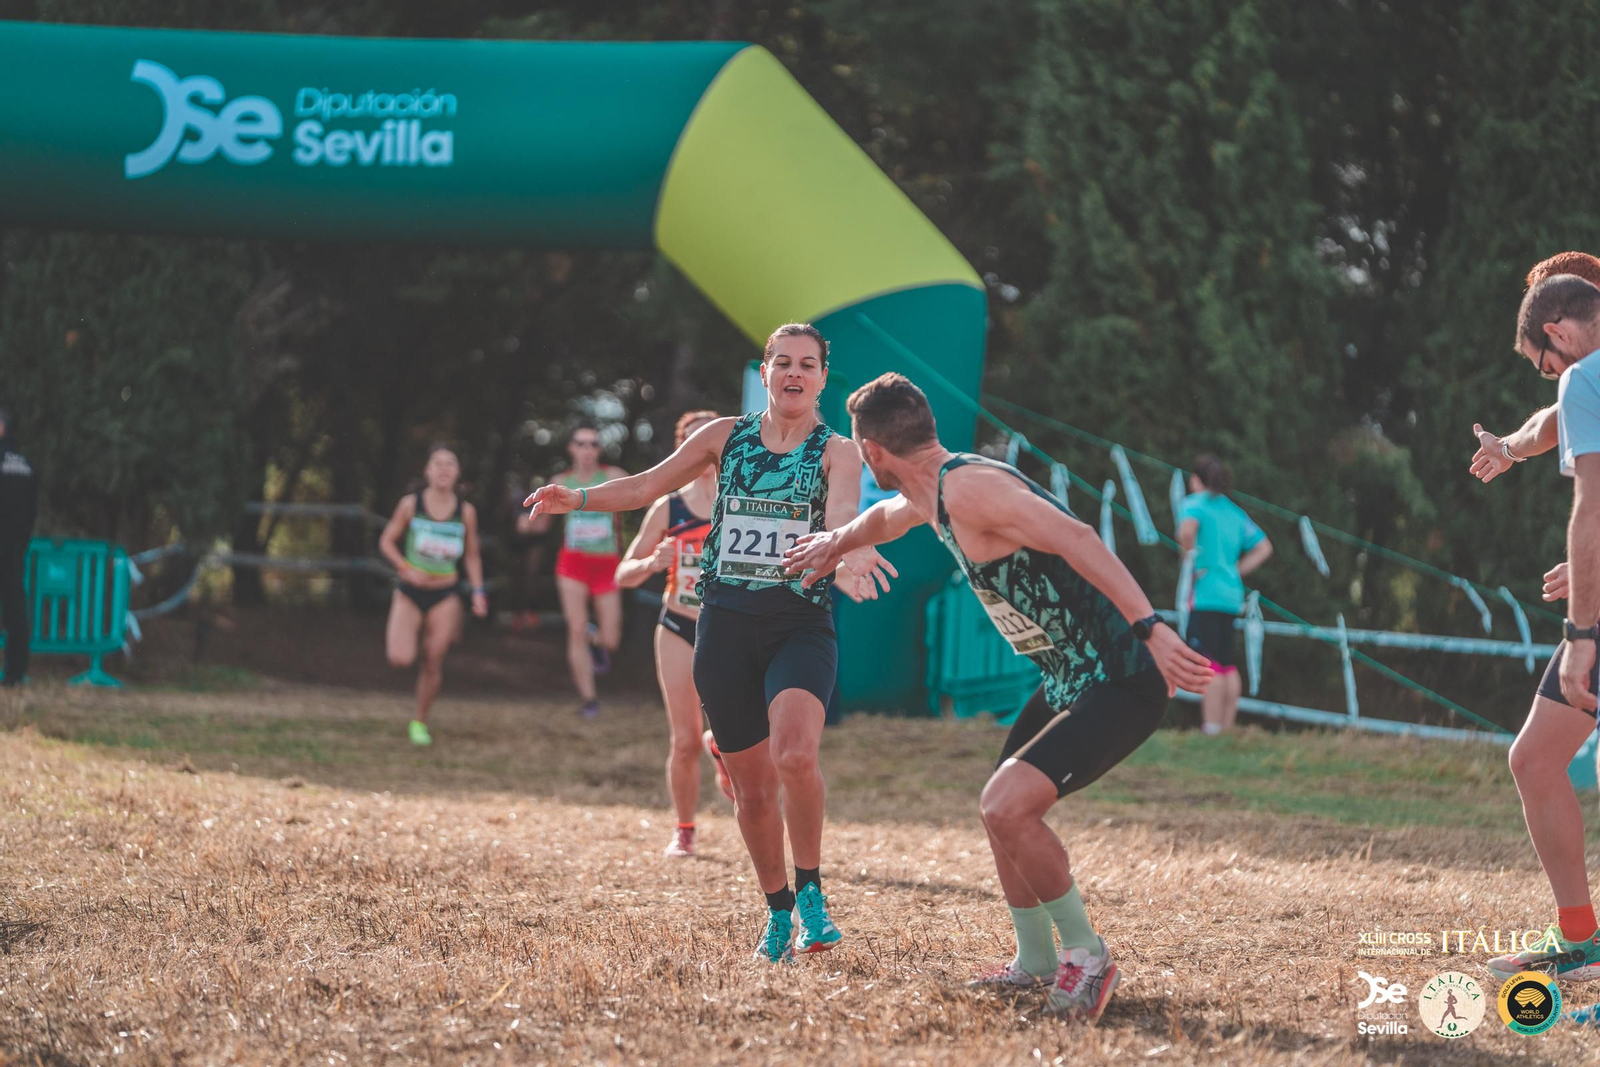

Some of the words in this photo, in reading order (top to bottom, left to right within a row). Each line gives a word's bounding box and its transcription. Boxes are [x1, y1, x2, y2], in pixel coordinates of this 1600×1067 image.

[293, 86, 458, 122] Diputación
[292, 118, 455, 168] Sevilla
[745, 500, 789, 515] ITÁLICA
